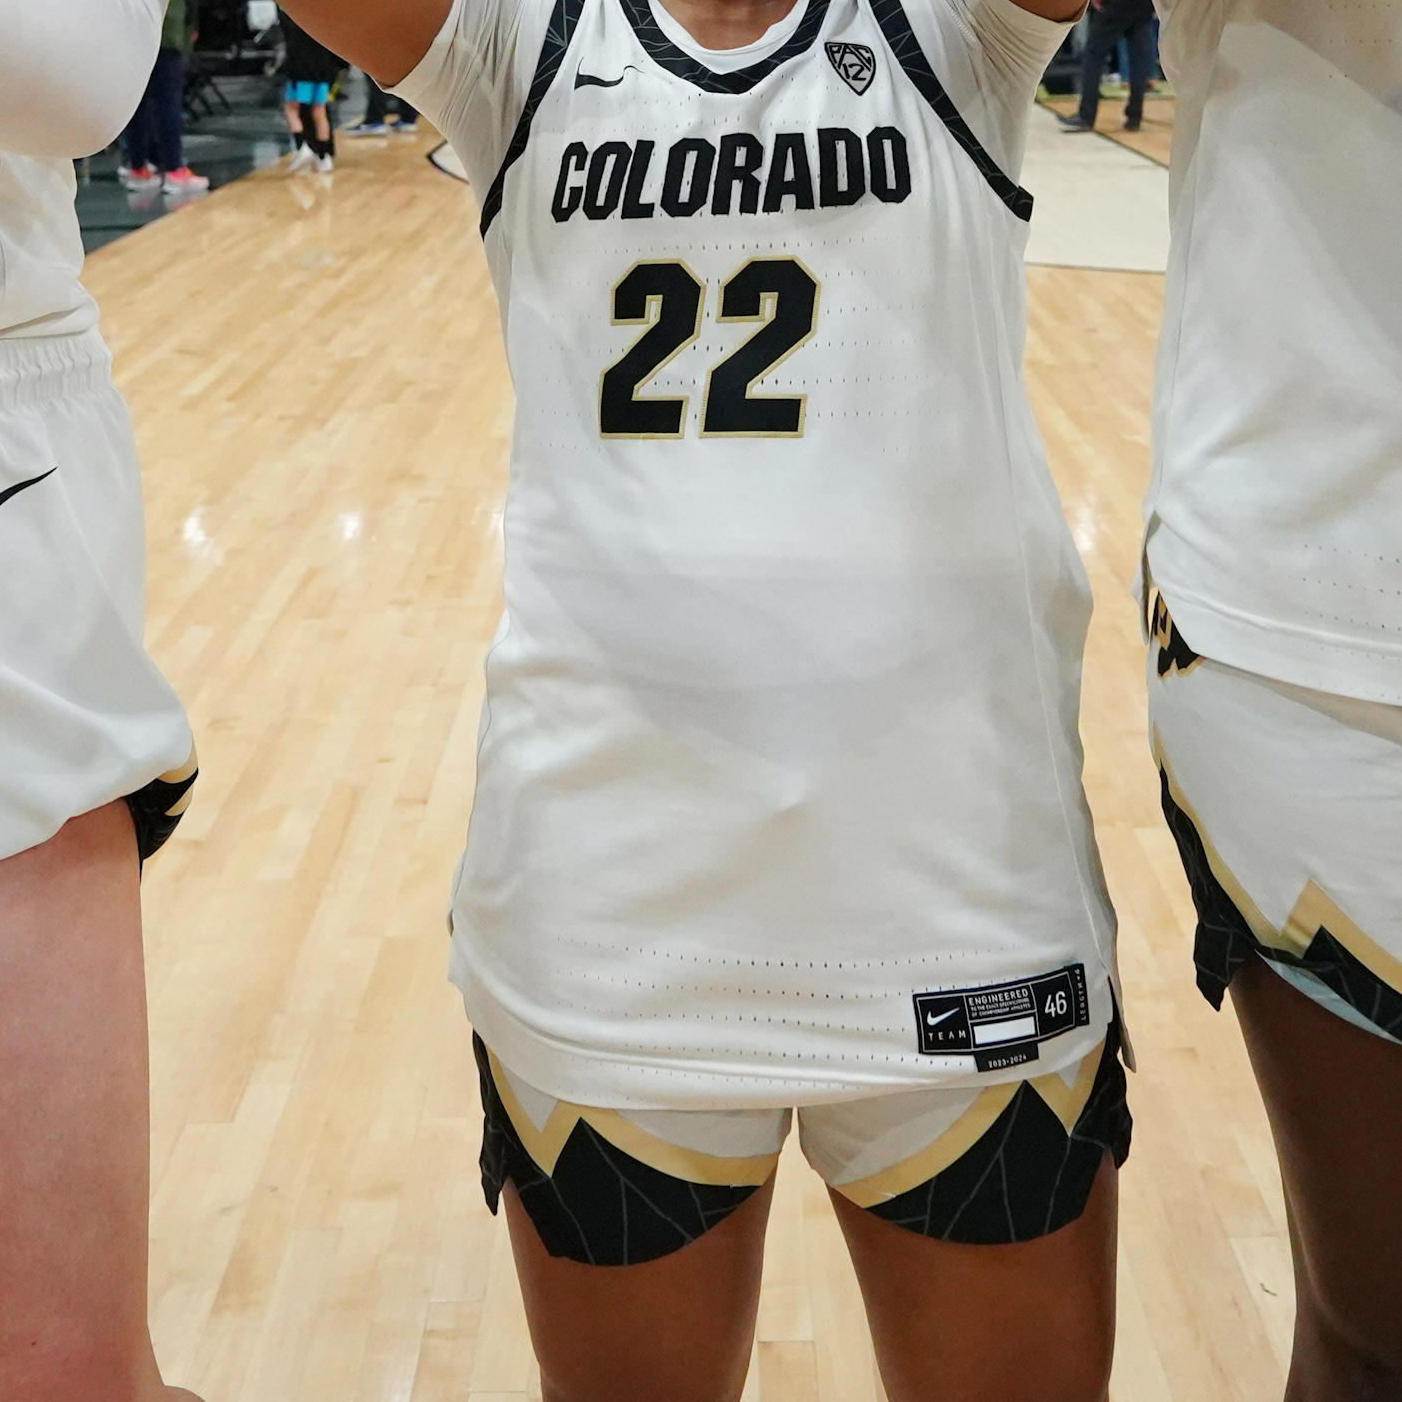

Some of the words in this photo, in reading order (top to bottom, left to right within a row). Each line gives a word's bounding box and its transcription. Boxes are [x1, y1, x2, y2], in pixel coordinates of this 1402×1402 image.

[829, 44, 872, 72] PAC
[842, 63, 867, 81] 12
[551, 125, 913, 224] COLORADO
[598, 256, 822, 440] 22
[968, 988, 1029, 1007] ENGINEERED
[1044, 991, 1068, 1018] 46
[928, 1030, 967, 1041] TEAM
